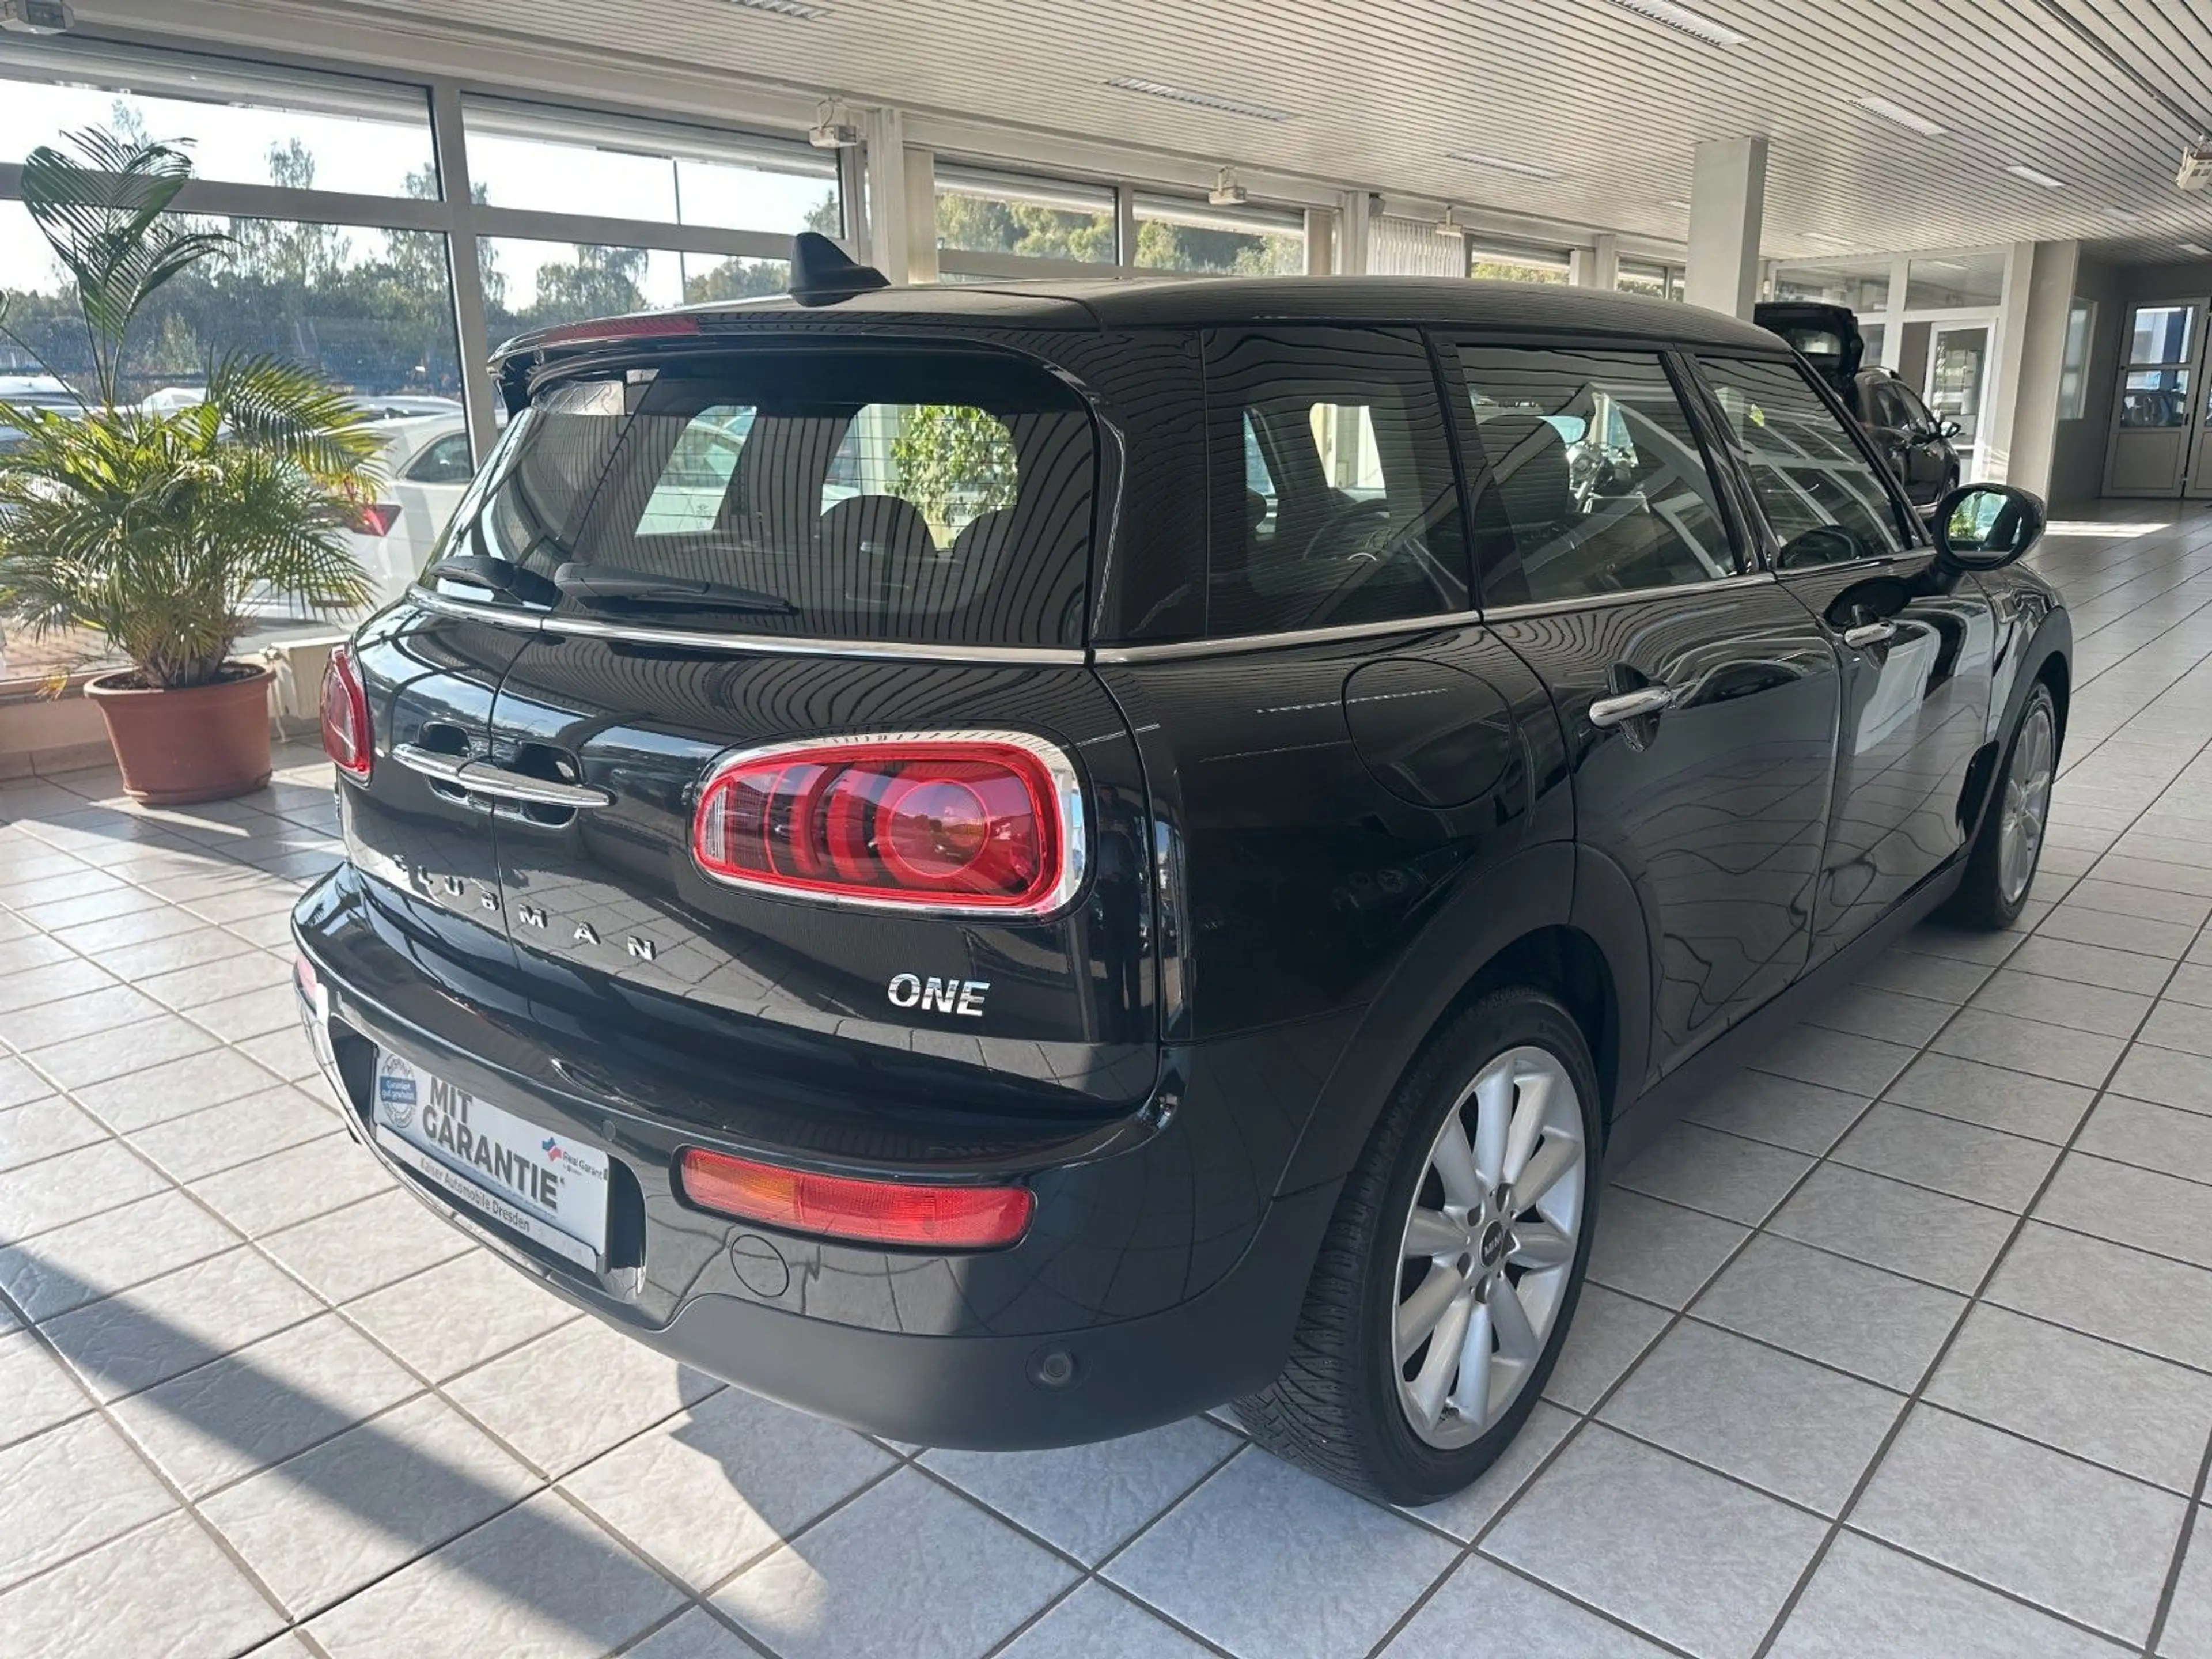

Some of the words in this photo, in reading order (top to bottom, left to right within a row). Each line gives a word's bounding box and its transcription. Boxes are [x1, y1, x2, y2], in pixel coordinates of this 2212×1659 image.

[888, 973, 991, 1016] ONE
[431, 1075, 473, 1124] MIT
[445, 1173, 490, 1210] Automobile
[493, 1199, 531, 1233] Dresden
